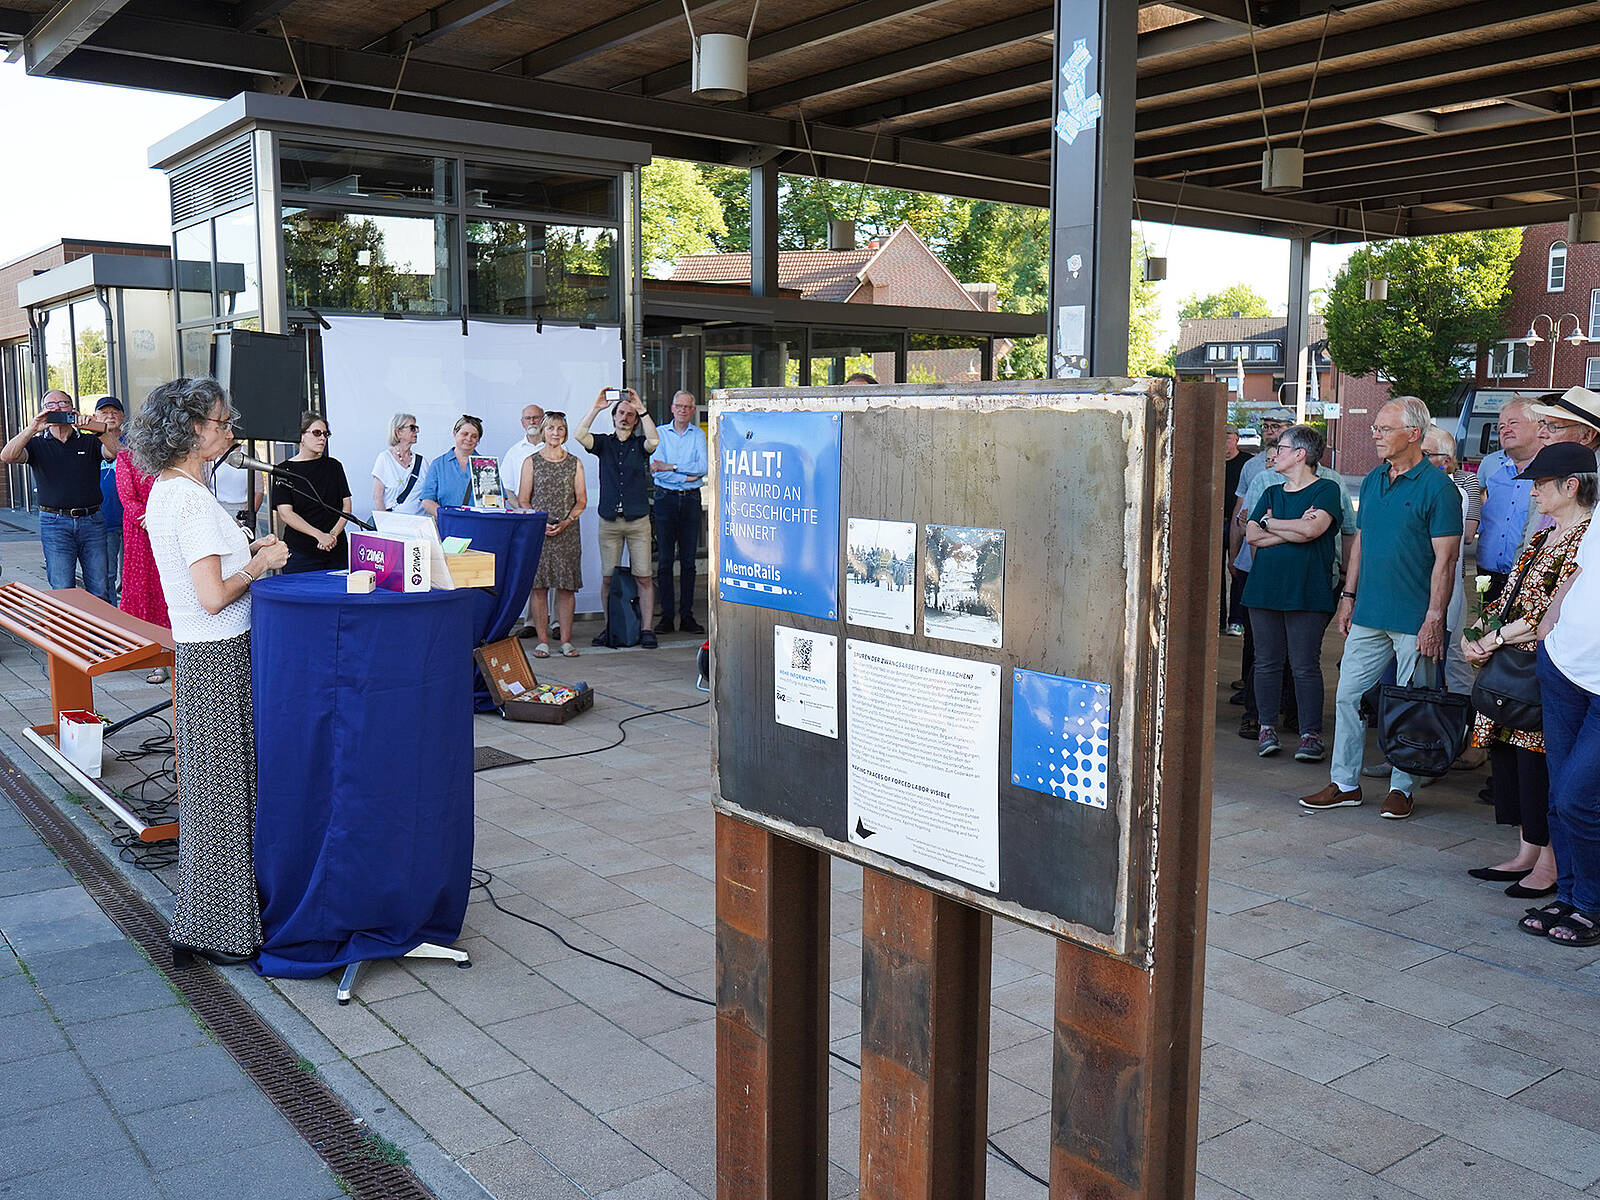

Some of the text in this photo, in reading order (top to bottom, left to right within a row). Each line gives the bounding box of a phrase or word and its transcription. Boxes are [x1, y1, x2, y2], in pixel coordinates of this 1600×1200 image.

[725, 450, 782, 478] HALT!
[725, 480, 801, 501] HIER WIRD AN
[725, 501, 818, 525] NS-GESCHICHTE
[725, 521, 776, 541] ERINNERT
[366, 548, 385, 564] ZUMBA
[412, 546, 421, 573] ZUMBA
[725, 558, 781, 581] MemoRails
[881, 657, 920, 671] ZWANGSARBEIT
[920, 665, 946, 677] SICHTBAR
[946, 671, 974, 681] MACHEN?
[866, 769, 884, 780] TRACES
[891, 777, 912, 788] FORCED
[912, 783, 929, 793] LABOR
[930, 788, 951, 799] VISIBLE
